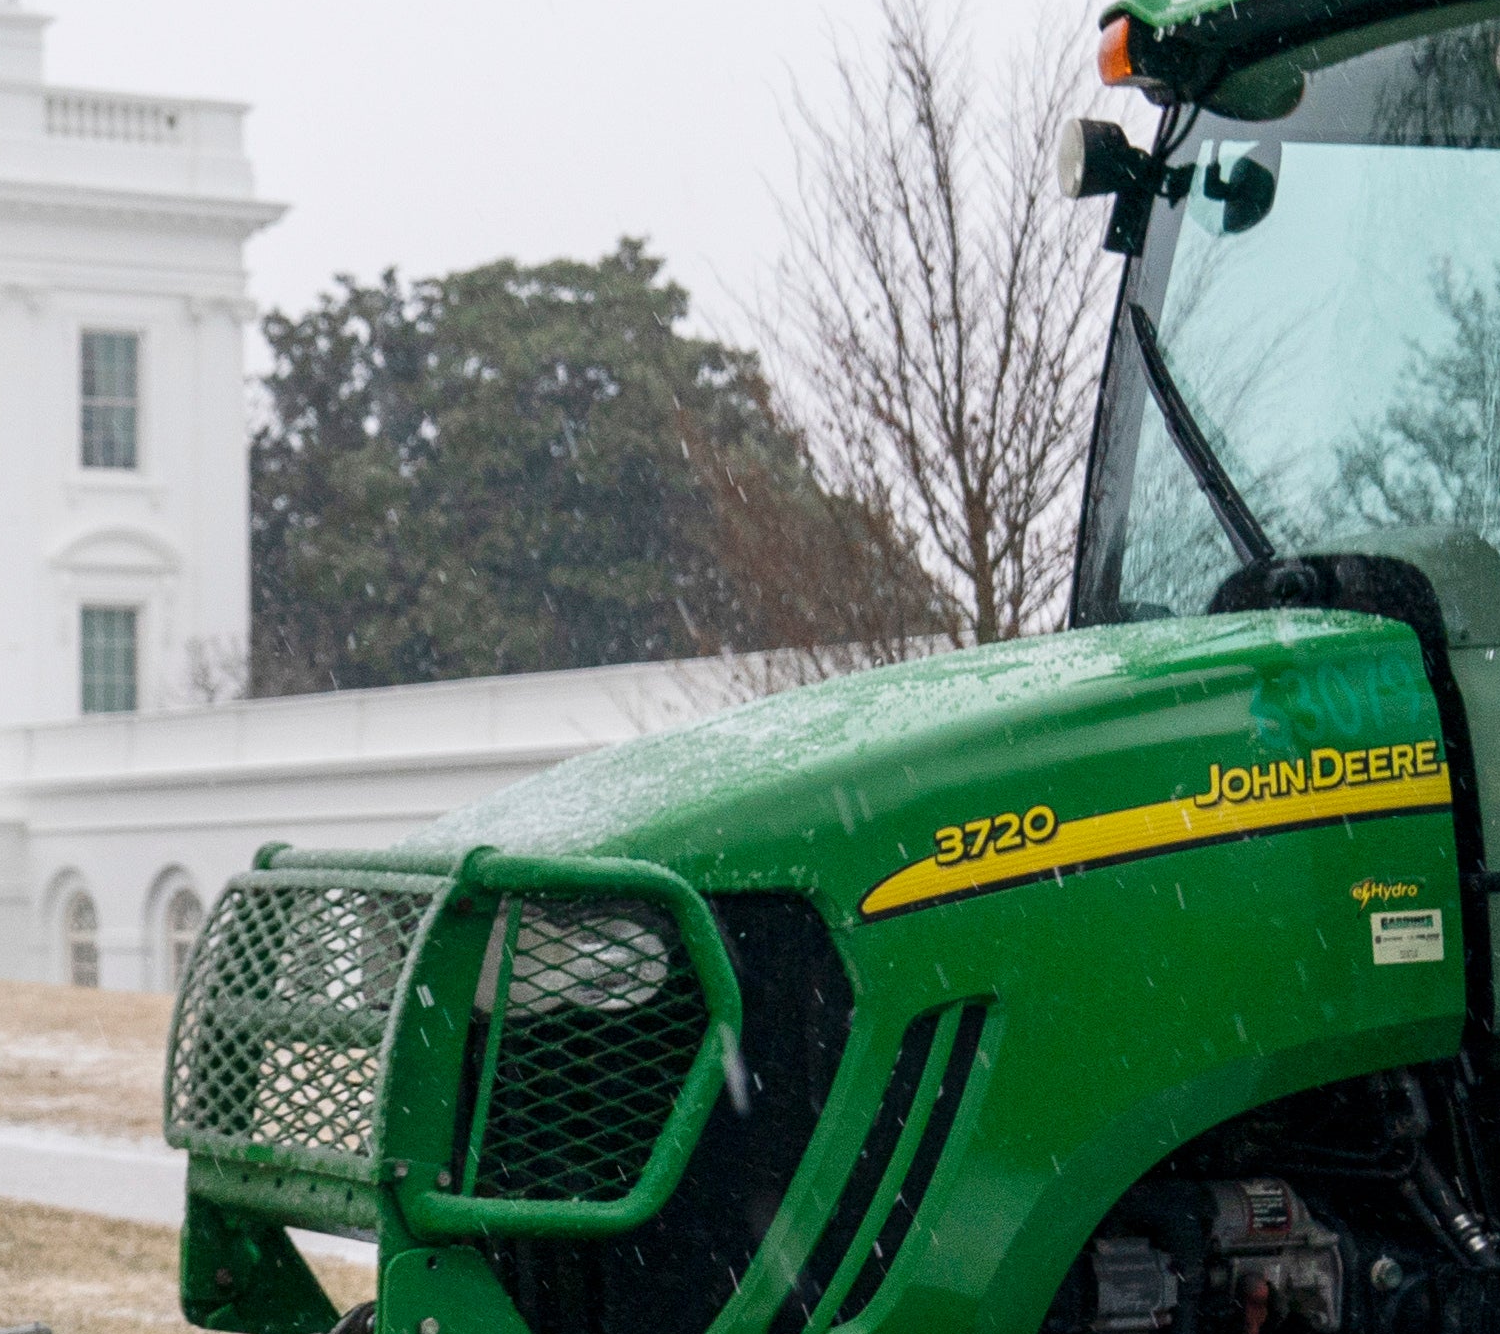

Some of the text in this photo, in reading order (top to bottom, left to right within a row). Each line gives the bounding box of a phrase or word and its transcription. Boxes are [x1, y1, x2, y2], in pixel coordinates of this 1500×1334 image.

[1194, 740, 1439, 808] JOHN DEERE
[934, 804, 1058, 866] 3720
